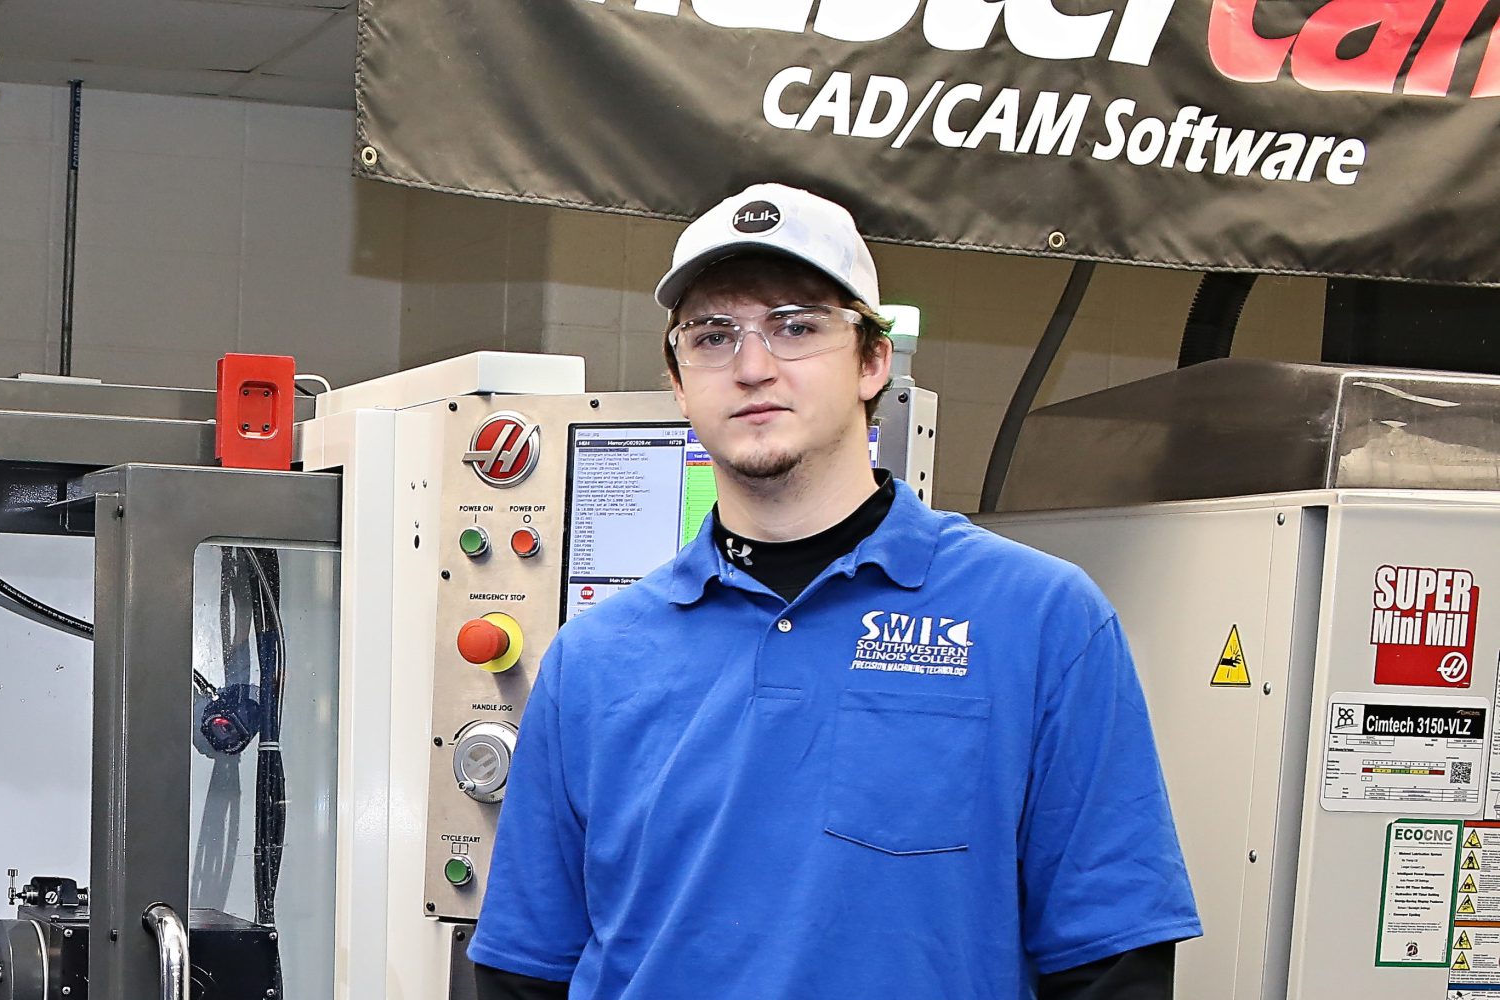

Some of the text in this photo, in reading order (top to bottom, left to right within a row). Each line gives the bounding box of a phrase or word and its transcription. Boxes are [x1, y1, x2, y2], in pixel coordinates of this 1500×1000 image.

[762, 66, 1367, 186] CAD/CAM Software
[733, 210, 780, 225] Huk
[469, 593, 509, 601] EMERGENCY
[1375, 566, 1472, 612] SUPER
[1372, 609, 1469, 648] Mini Mill
[856, 640, 968, 657] SOUTHWESTERN
[855, 649, 968, 666] ILLINOIS COLLEGE
[851, 660, 887, 671] PRECISION
[925, 665, 967, 677] TECHNOLOGY
[498, 704, 513, 712] JOG
[1366, 715, 1472, 735] Cimtech 3150-VLZ
[441, 834, 481, 843] CYCLE START
[1394, 828, 1454, 841] ECOCNC
